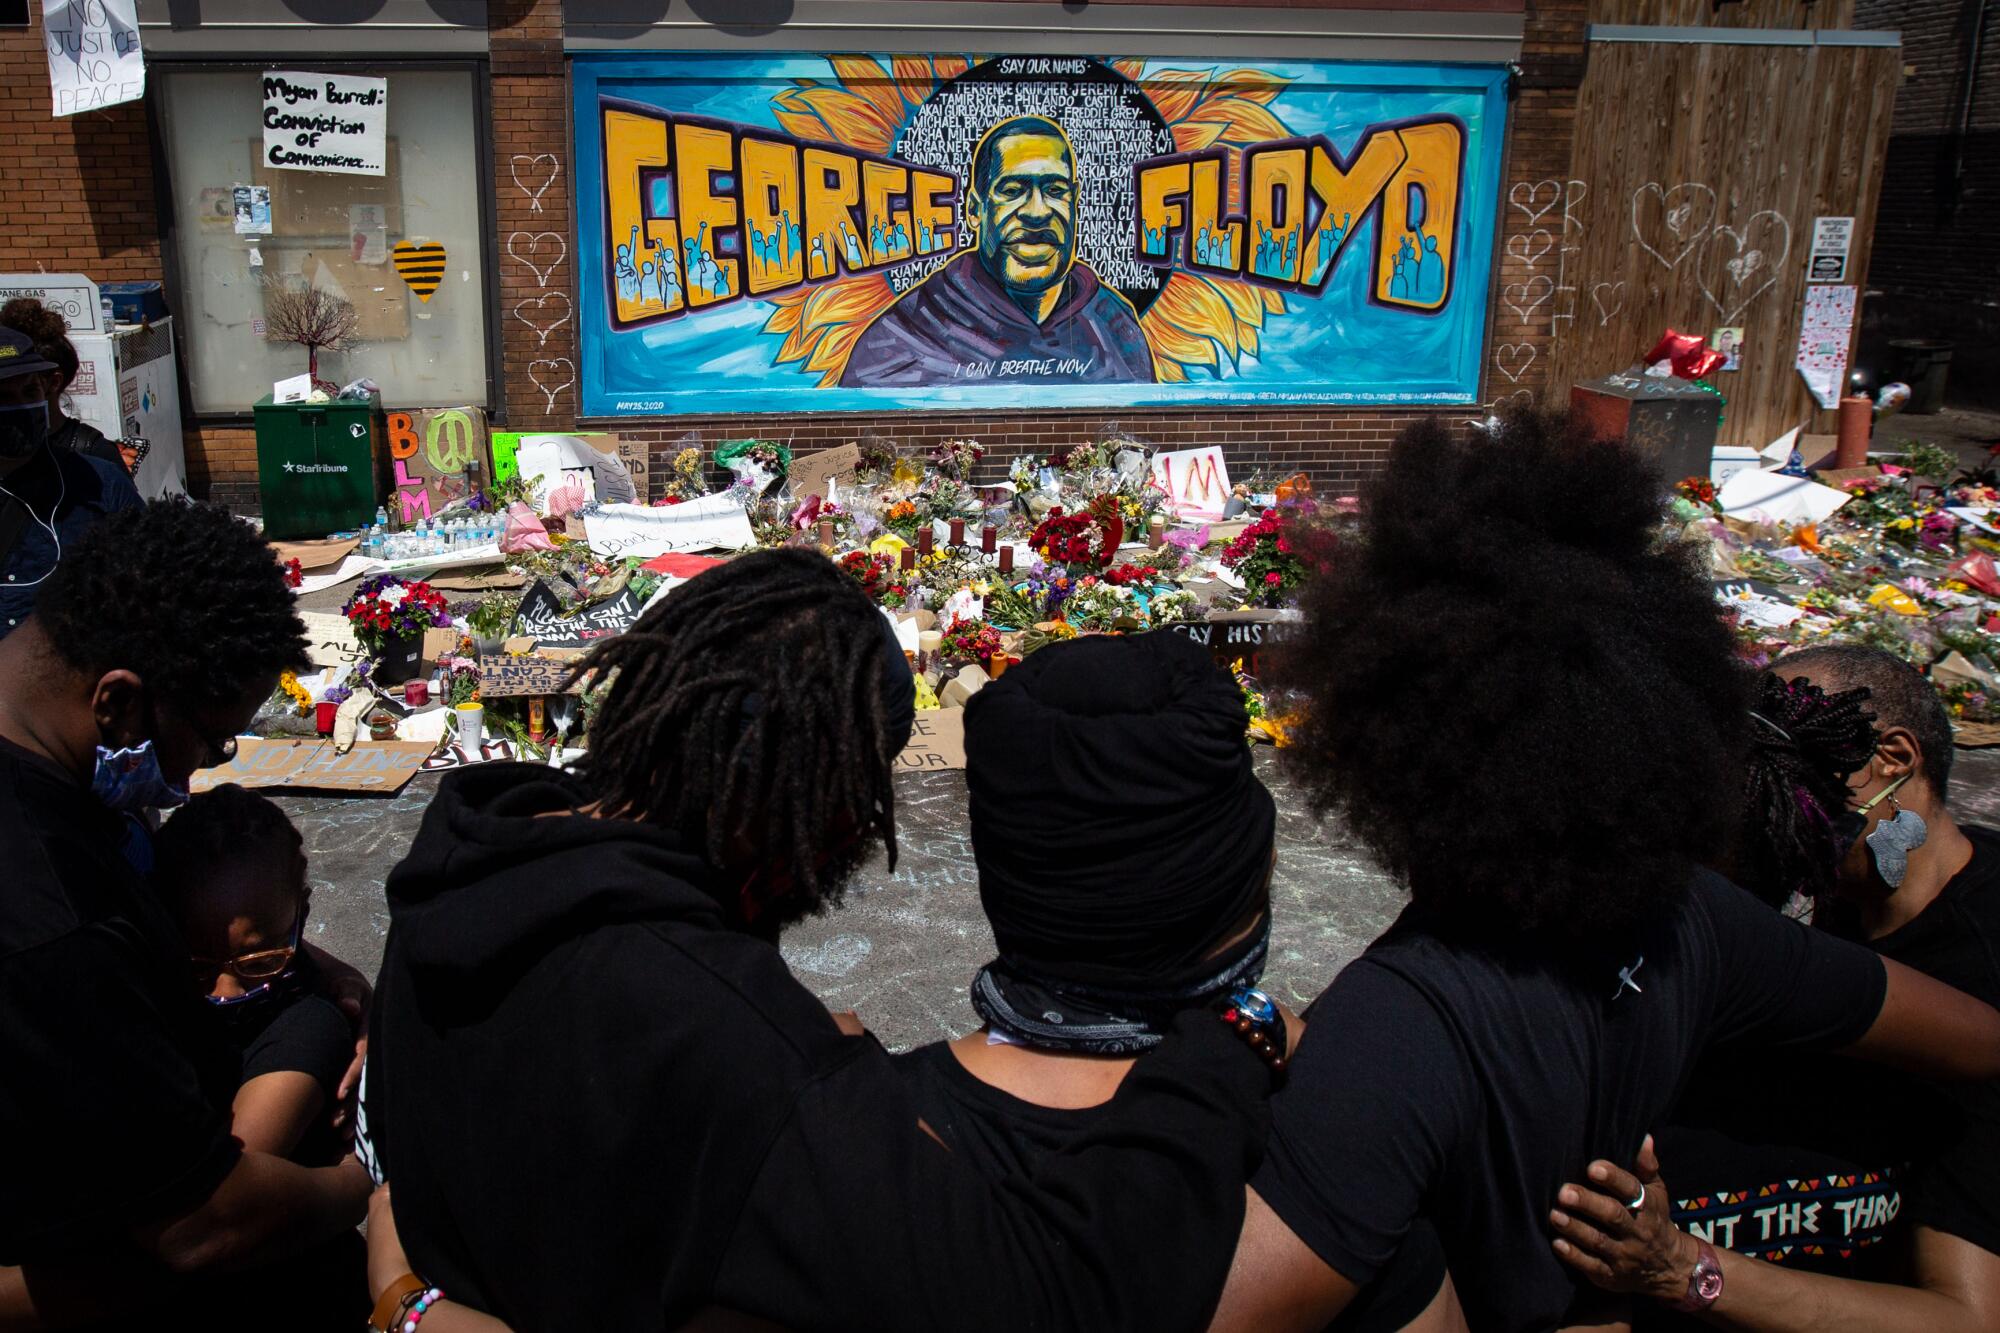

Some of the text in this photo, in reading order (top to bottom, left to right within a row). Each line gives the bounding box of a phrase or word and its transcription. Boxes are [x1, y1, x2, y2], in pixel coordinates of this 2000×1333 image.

[67, 0, 107, 28] NO
[49, 30, 140, 56] JUSTICE
[76, 59, 112, 85] NO
[1000, 58, 1087, 74] SAY OUR NAMES
[954, 82, 1014, 96] TERRENCE
[1015, 82, 1068, 96] CRUTCHER
[1072, 82, 1119, 96] JEREMY
[939, 93, 1127, 108] TAMIR RICE PHILANDO CASTILE
[918, 104, 942, 117] AKAI
[1020, 105, 1057, 118] JAMES
[1065, 107, 1108, 119] FREDDIE
[1110, 107, 1140, 120] GREY
[263, 106, 365, 134] Conviction
[913, 116, 962, 129] MICHAEL
[1058, 117, 1102, 129] TERRANCE
[1103, 118, 1150, 129] FRANKLIN
[904, 127, 944, 142] TYISHA
[1067, 129, 1115, 142] BREONNA
[1114, 129, 1153, 142] TAYLOR
[896, 140, 923, 153] ERIC
[923, 141, 971, 154] GARNER
[1072, 141, 1120, 154] SHANTEL
[1121, 141, 1151, 154] DAVIS
[904, 152, 950, 165] SANDRA
[1074, 153, 1117, 166] WALTER
[1076, 165, 1107, 178] REKIA
[1078, 191, 1117, 206] SHELLY
[602, 103, 1464, 324] GEORGE FLOYD
[1078, 205, 1115, 221] JAMAR
[1077, 220, 1124, 235] TANISHA
[1076, 234, 1117, 247] TARIKA
[1076, 246, 1112, 261] ALTON
[1104, 276, 1160, 289] KATHRYN
[25, 289, 46, 298] GAS
[953, 358, 1093, 377] I CAN BREATHE NOW
[296, 462, 348, 474] StarTribune
[1228, 623, 1263, 645] HIS
[891, 753, 948, 767] UR
[1752, 1201, 1822, 1242] THE
